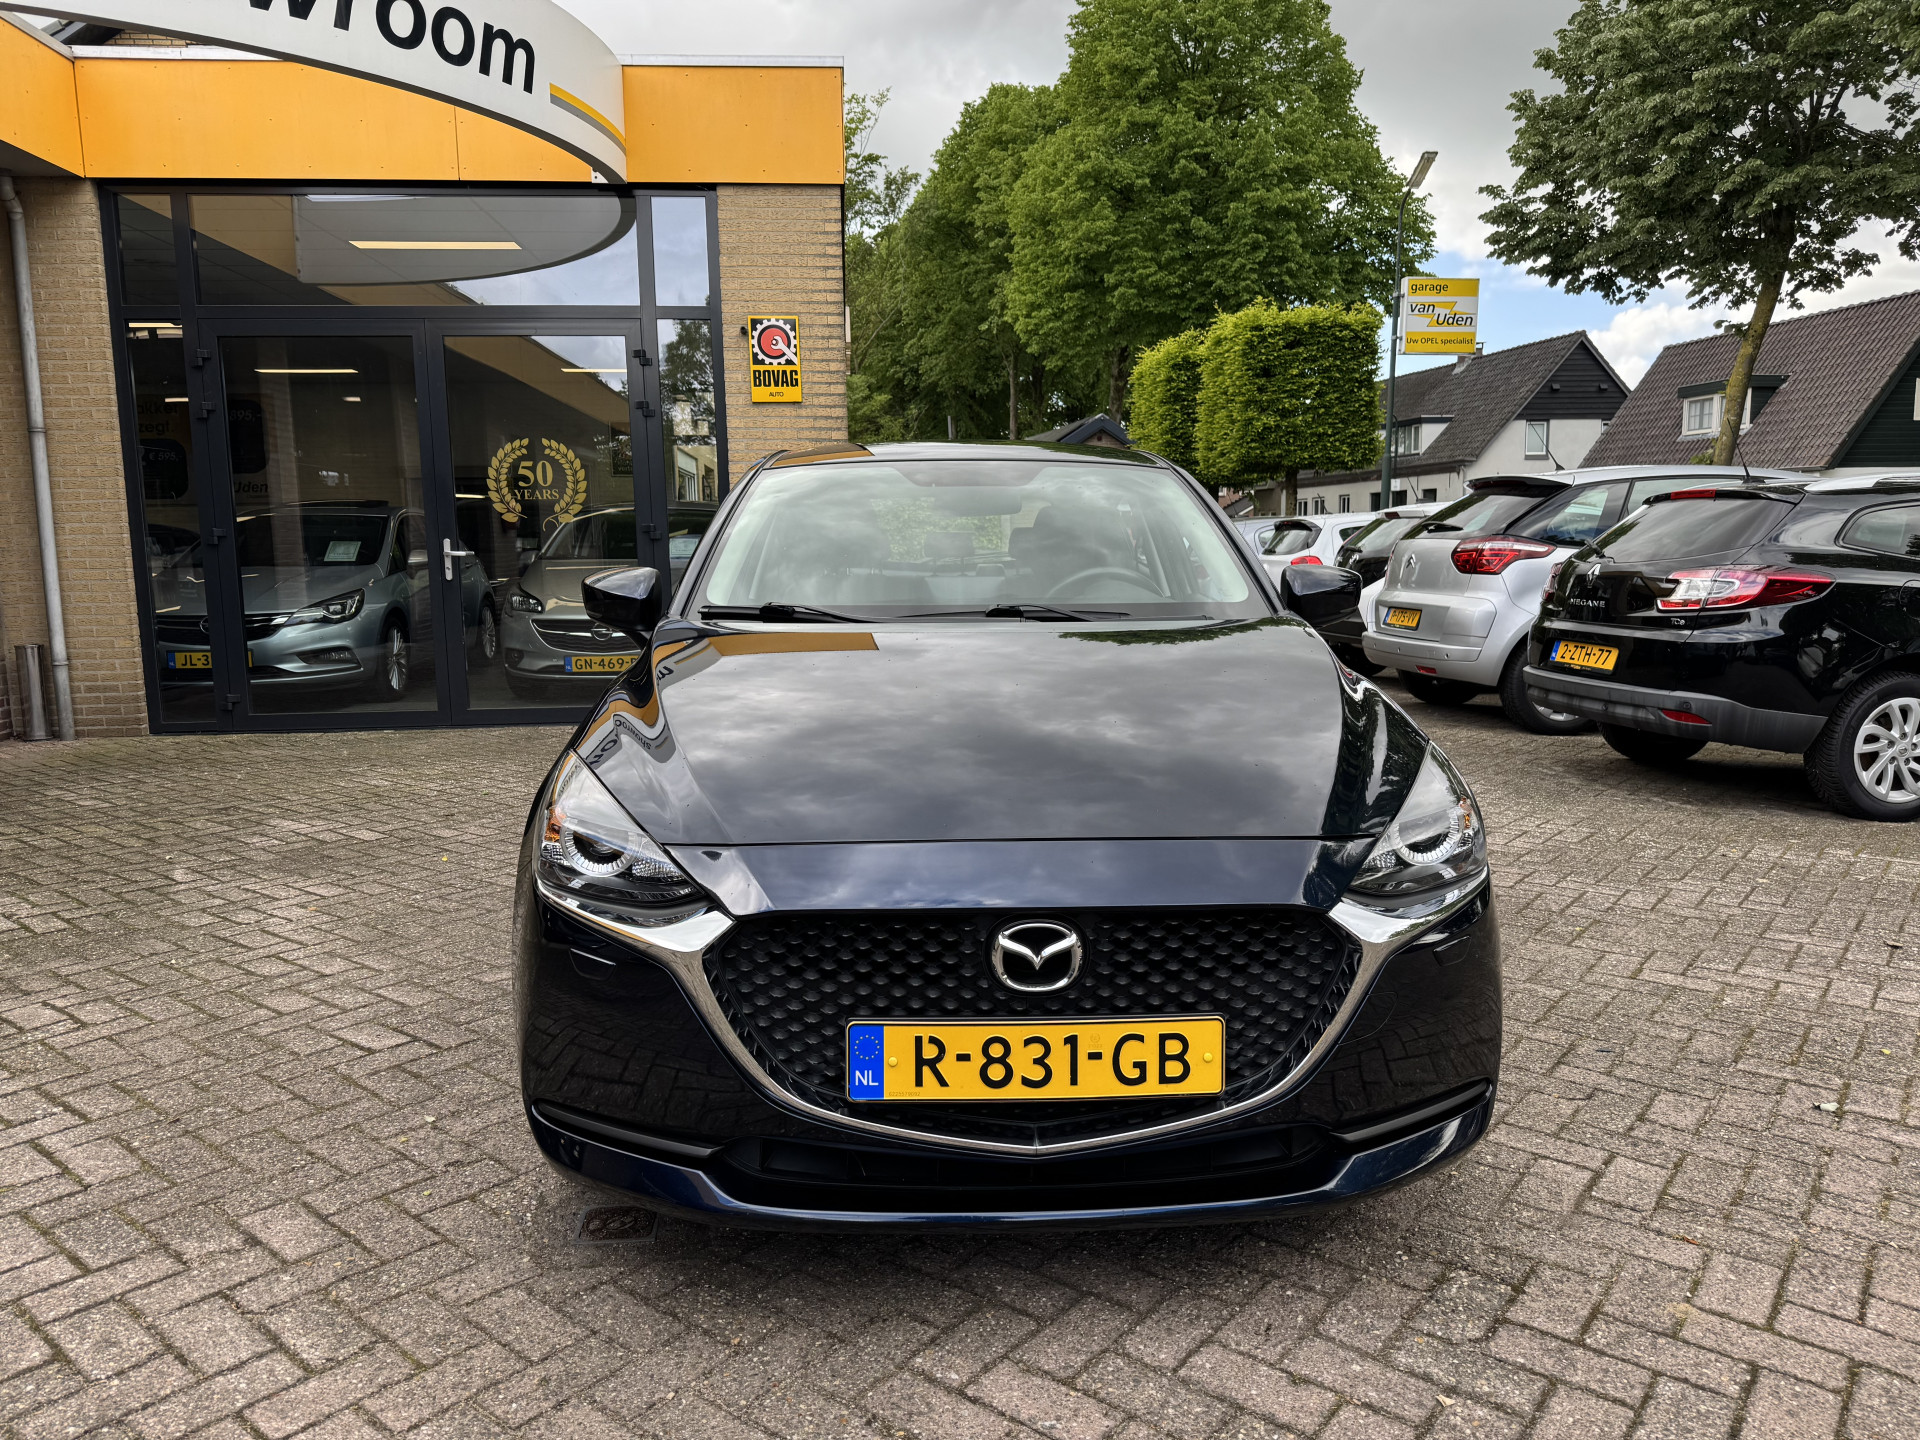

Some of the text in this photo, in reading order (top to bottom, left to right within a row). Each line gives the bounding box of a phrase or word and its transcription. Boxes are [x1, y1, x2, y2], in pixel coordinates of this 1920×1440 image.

[1411, 283, 1449, 294] garage
[1410, 303, 1436, 313] van
[1436, 313, 1473, 326] Uden
[1440, 337, 1473, 346] specialist
[753, 370, 799, 387] BOVAG
[517, 460, 553, 487] 50
[514, 489, 560, 500] YEARS
[1570, 598, 1605, 608] MEGANE
[1560, 643, 1612, 666] 2-ZTH-77
[855, 1032, 1191, 1089] NL R-831-GB
